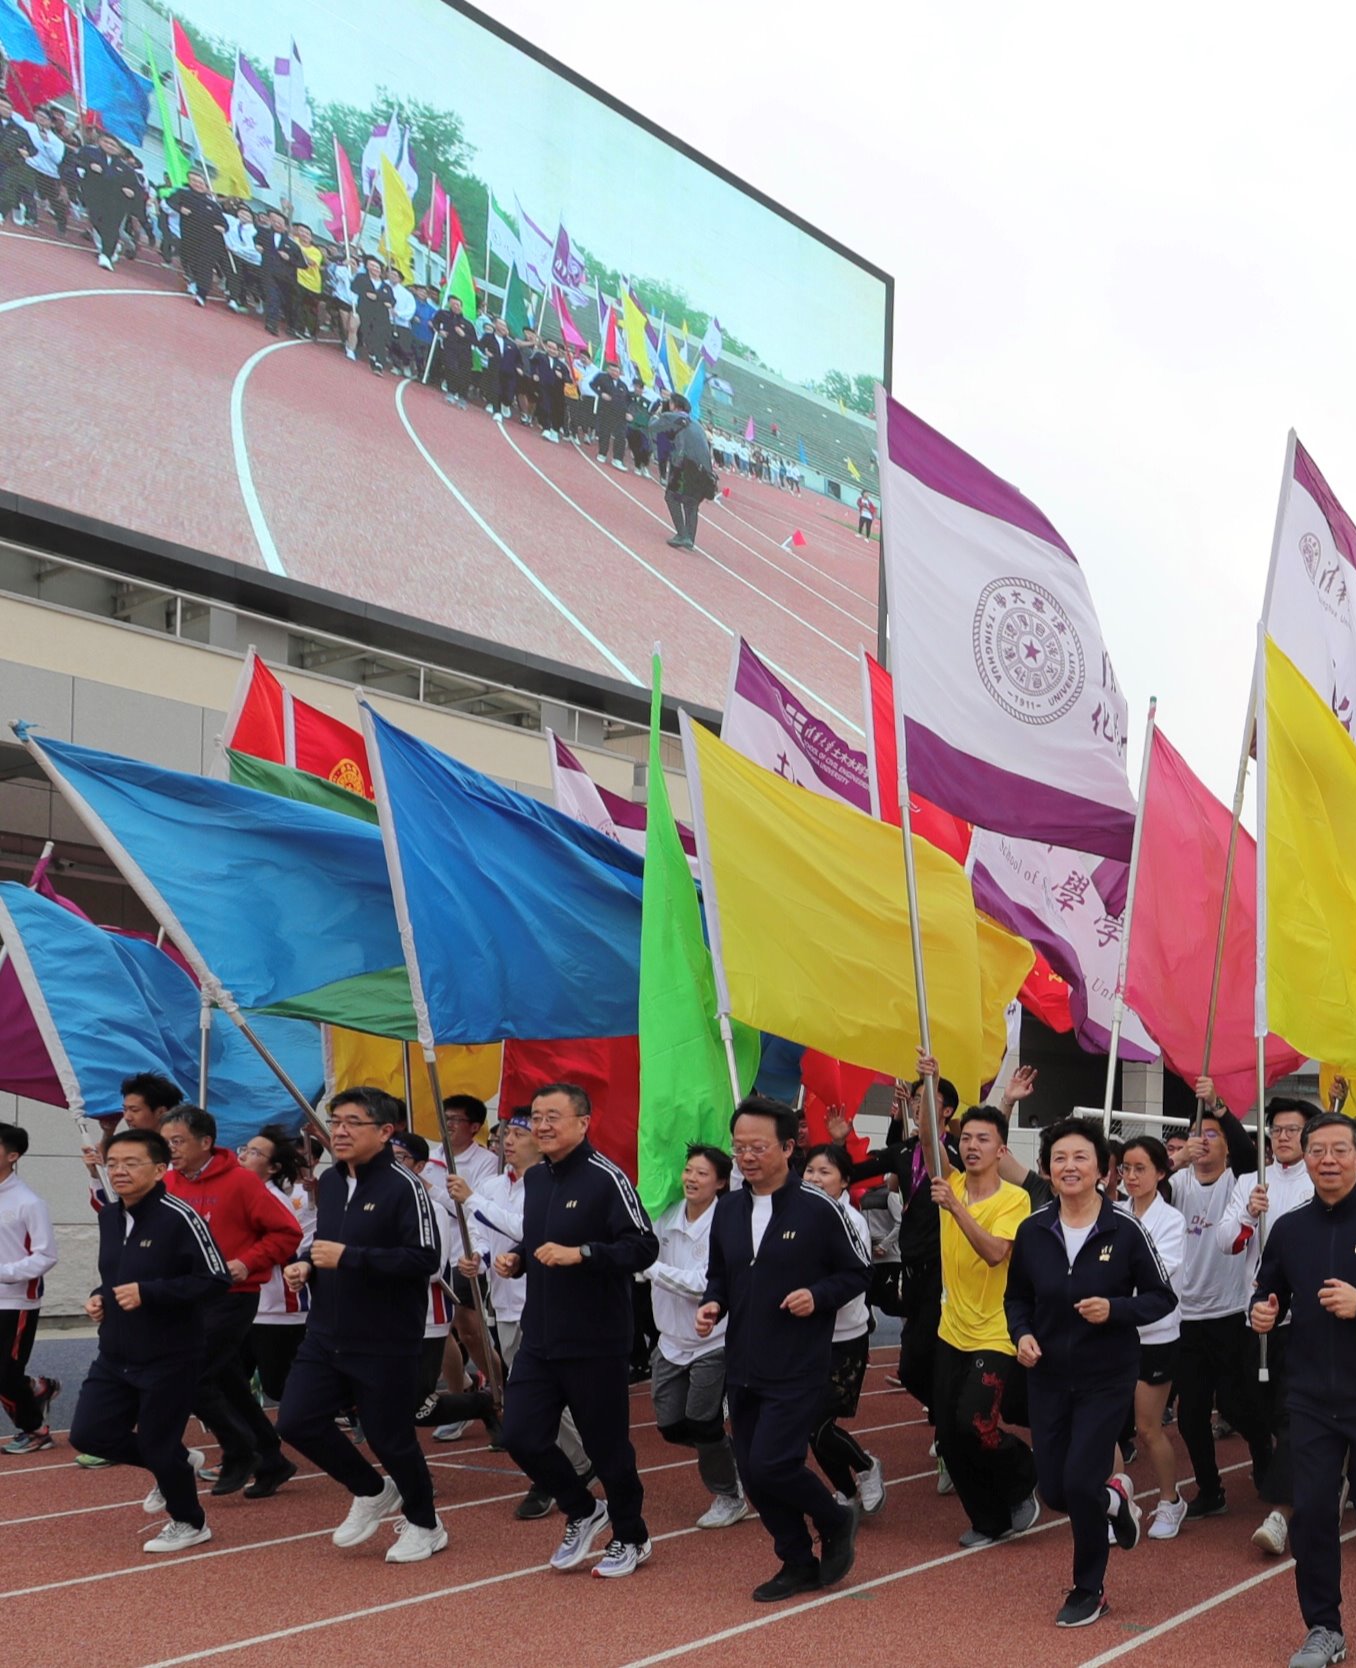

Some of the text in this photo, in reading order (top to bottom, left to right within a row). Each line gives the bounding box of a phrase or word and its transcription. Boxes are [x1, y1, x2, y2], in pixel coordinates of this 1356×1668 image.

[984, 613, 1003, 685] TSINGHUA
[1047, 651, 1078, 707] UNIVERSITY
[1023, 870, 1040, 886] of
